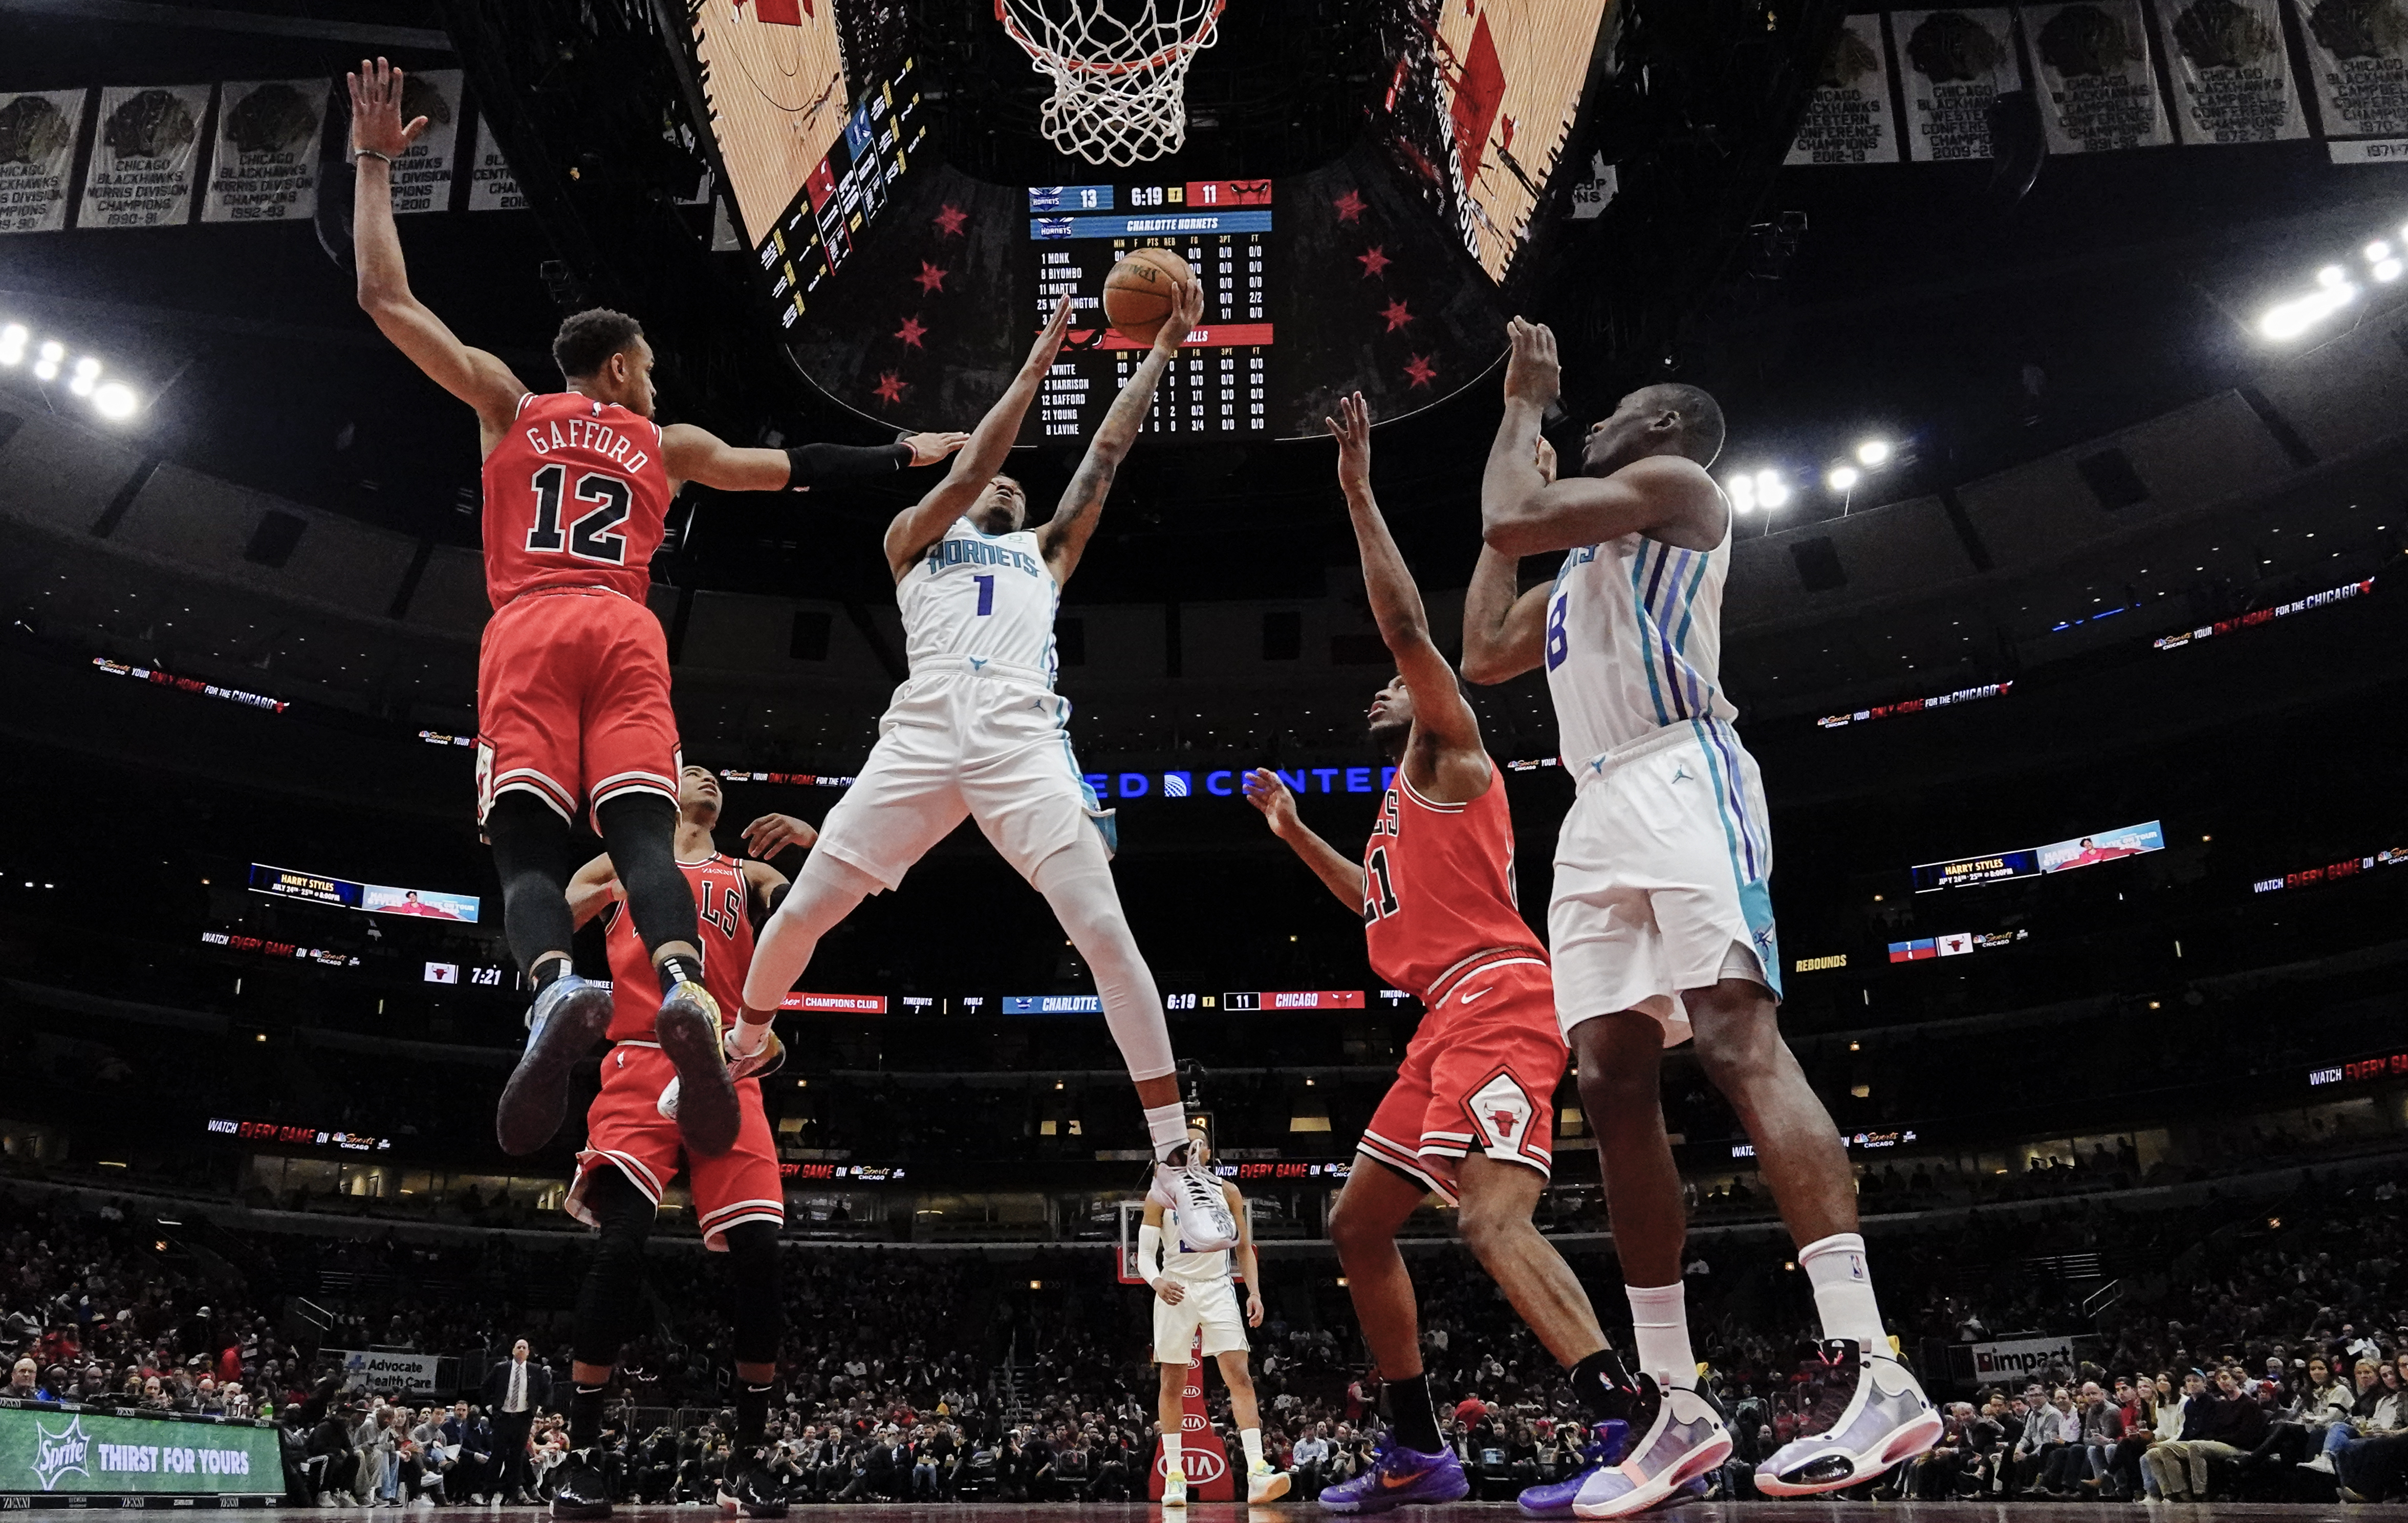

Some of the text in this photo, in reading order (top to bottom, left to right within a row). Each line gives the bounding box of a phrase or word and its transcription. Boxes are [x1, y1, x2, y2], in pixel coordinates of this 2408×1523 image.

[1797, 138, 1878, 151] CHAMPIONS
[239, 153, 293, 166] CHICAGO
[1813, 151, 1865, 163] 2012-13
[116, 159, 171, 172] CHICAGO
[220, 164, 307, 179] BLACKHAWKS
[97, 170, 183, 185] BLACKHAWKS
[87, 184, 188, 199] NORRIS DIVISION
[212, 180, 256, 192] NORRIS
[839, 169, 859, 214] 6:19
[223, 190, 296, 204] CHAMPIONS
[1080, 189, 1097, 208] 13
[1131, 187, 1162, 206] 6:19
[1203, 185, 1217, 203] 11
[97, 198, 172, 211] CHAMPIONS
[1040, 226, 1072, 235] HORNETS
[1127, 218, 1218, 232] CHARLOTTE HORNETS
[1114, 234, 1259, 248] MIN PTS REB FG 3PT FT
[1048, 245, 1262, 264] MONK 0/0 0/0 0/0
[1049, 261, 1262, 279] BIYOMBO 0/0 0/0
[1039, 276, 1262, 295] 11 MARTIN 0/0 0/0
[1037, 291, 1262, 310] 25 0/0 2/2
[1221, 307, 1263, 319] 1/1 0/0
[1116, 351, 1127, 360] MIN
[1221, 348, 1232, 356] 3PT
[1051, 358, 1263, 376] WHITE 00 0/0 0/0 0/0
[1052, 373, 1263, 390] HARRISON 0/0 0/0 0/0
[1042, 388, 1264, 405] 12 GAFFORD 1/1 0/0 0/0
[1042, 403, 1264, 421] 21 YOUNG 0/3 0/1 0/0
[1053, 418, 1264, 435] LAVINE 3/4 0/0 0/0
[526, 419, 648, 474] GAFFORD
[525, 463, 633, 566] 12
[925, 539, 1041, 577] HORNETS
[973, 575, 994, 616] 1
[2275, 583, 2358, 617] FOR THE CHICAGO
[2194, 626, 2212, 639] YOUR
[100, 666, 125, 675] CHICAGO
[131, 668, 274, 710] YOUR FOR THE CHICAGO
[1853, 684, 1996, 721] YOUR FOR THE CHICAGO
[453, 737, 470, 746] YOUR
[1541, 758, 1557, 766] YOUR
[753, 773, 839, 786] YOUR ONLY HOME FOR THE
[1945, 858, 2004, 876] HARRY STYLES
[2254, 856, 2374, 893] WATCH ON
[281, 873, 334, 892] HARRY STYLES
[272, 883, 340, 902] JULY 8:00PM
[202, 932, 229, 945] WATCH
[296, 948, 307, 958] ON
[1982, 939, 2010, 948] CHICAGO
[317, 957, 342, 966] CHICAGO
[1796, 954, 1847, 973] REBOUNDS
[471, 968, 502, 985] 7:21
[805, 997, 855, 1009] CHAMPIONS
[857, 998, 878, 1009] CLUB
[903, 997, 932, 1006] TIMEOUTS
[964, 997, 983, 1006] FOULS
[1042, 997, 1097, 1011] CHARLOTTE
[1167, 994, 1196, 1009] 6:19
[1236, 995, 1249, 1008] 11
[1275, 993, 1318, 1007] CHICAGO
[2310, 1068, 2342, 1085] WATCH
[208, 1119, 238, 1133] WATCH
[316, 1132, 329, 1144] ON
[340, 1142, 369, 1150] CHICAGO
[802, 1164, 848, 1179] GAME ON
[863, 1166, 891, 1176] Sports
[1240, 1164, 1321, 1178] EVERY GAME ON
[368, 1359, 423, 1373] Advocate
[406, 1376, 431, 1388] Care
[40, 1437, 84, 1474] Sprite
[98, 1444, 249, 1475] THIRST FOR YOURS
[1181, 1456, 1214, 1476] IA
